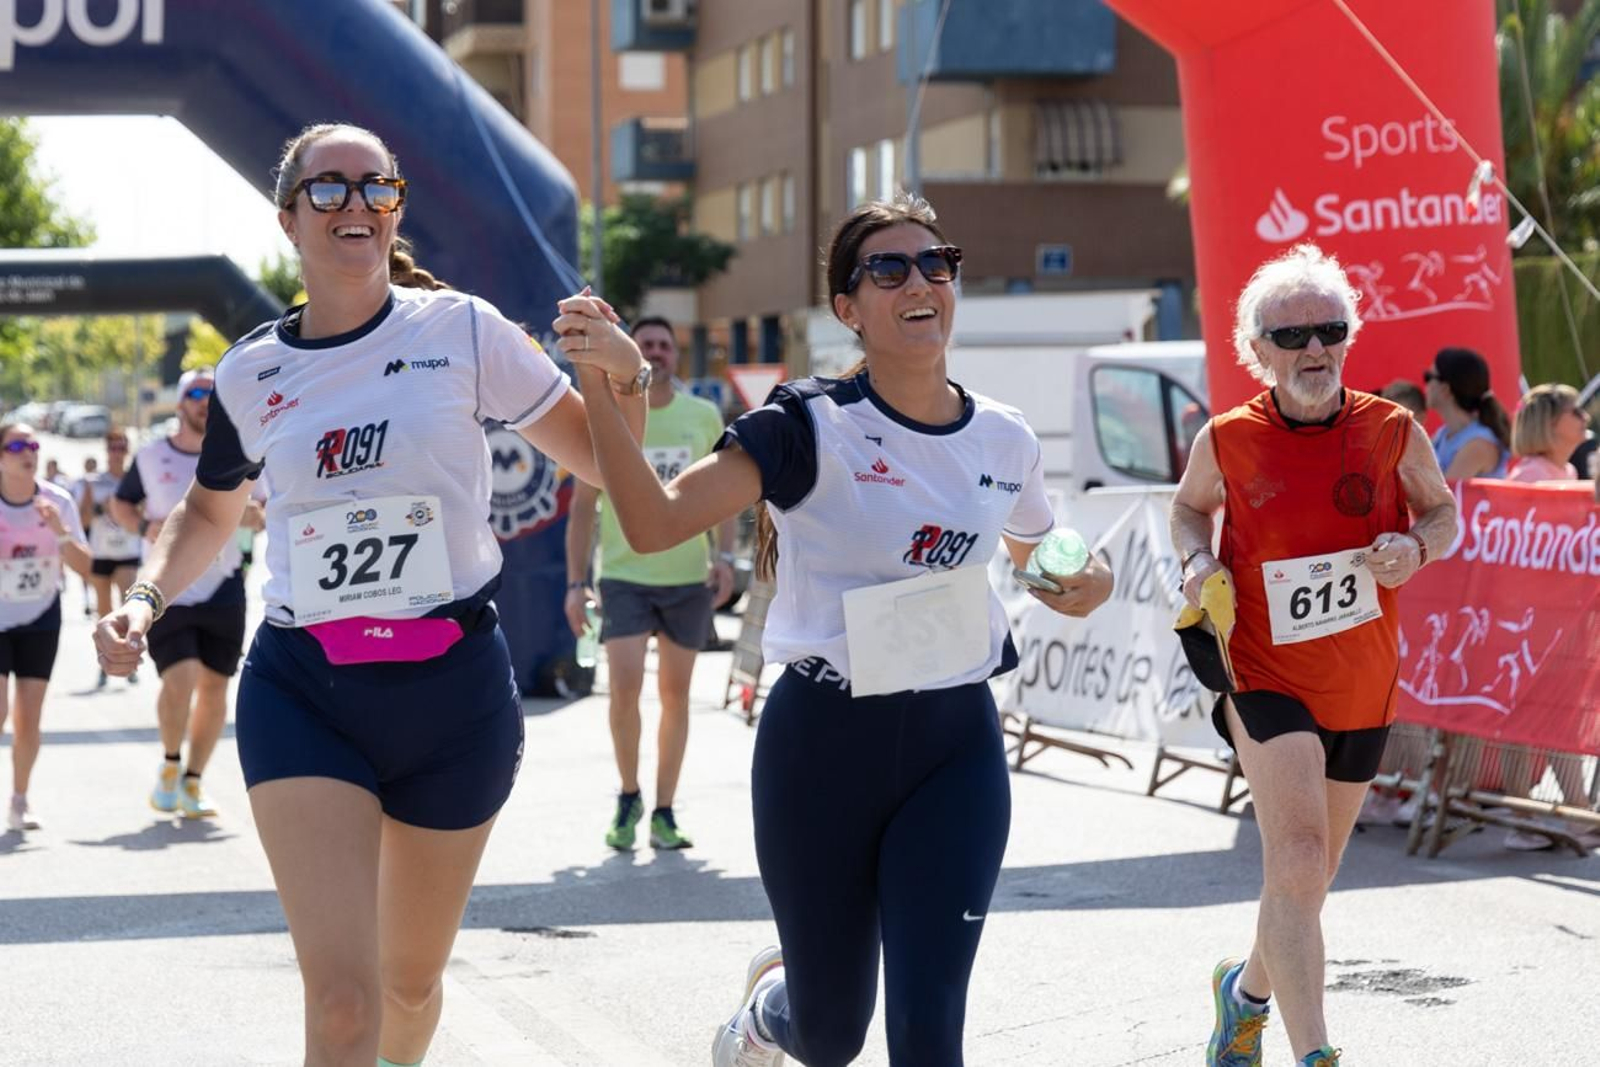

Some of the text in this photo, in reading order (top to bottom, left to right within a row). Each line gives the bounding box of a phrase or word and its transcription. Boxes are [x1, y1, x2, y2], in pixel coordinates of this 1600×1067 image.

[1321, 112, 1459, 169] Sports
[1313, 187, 1502, 237] Santander
[411, 355, 450, 370] mupol
[854, 471, 906, 487] Santander
[996, 481, 1021, 495] mupo
[1462, 499, 1600, 576] Santande
[318, 533, 419, 591] 327
[339, 594, 363, 603] MIRIAM
[363, 588, 387, 598] COBOS
[1290, 574, 1357, 620] 613
[364, 627, 394, 638] FILA
[791, 656, 851, 690] EP
[1018, 628, 1114, 704] portes
